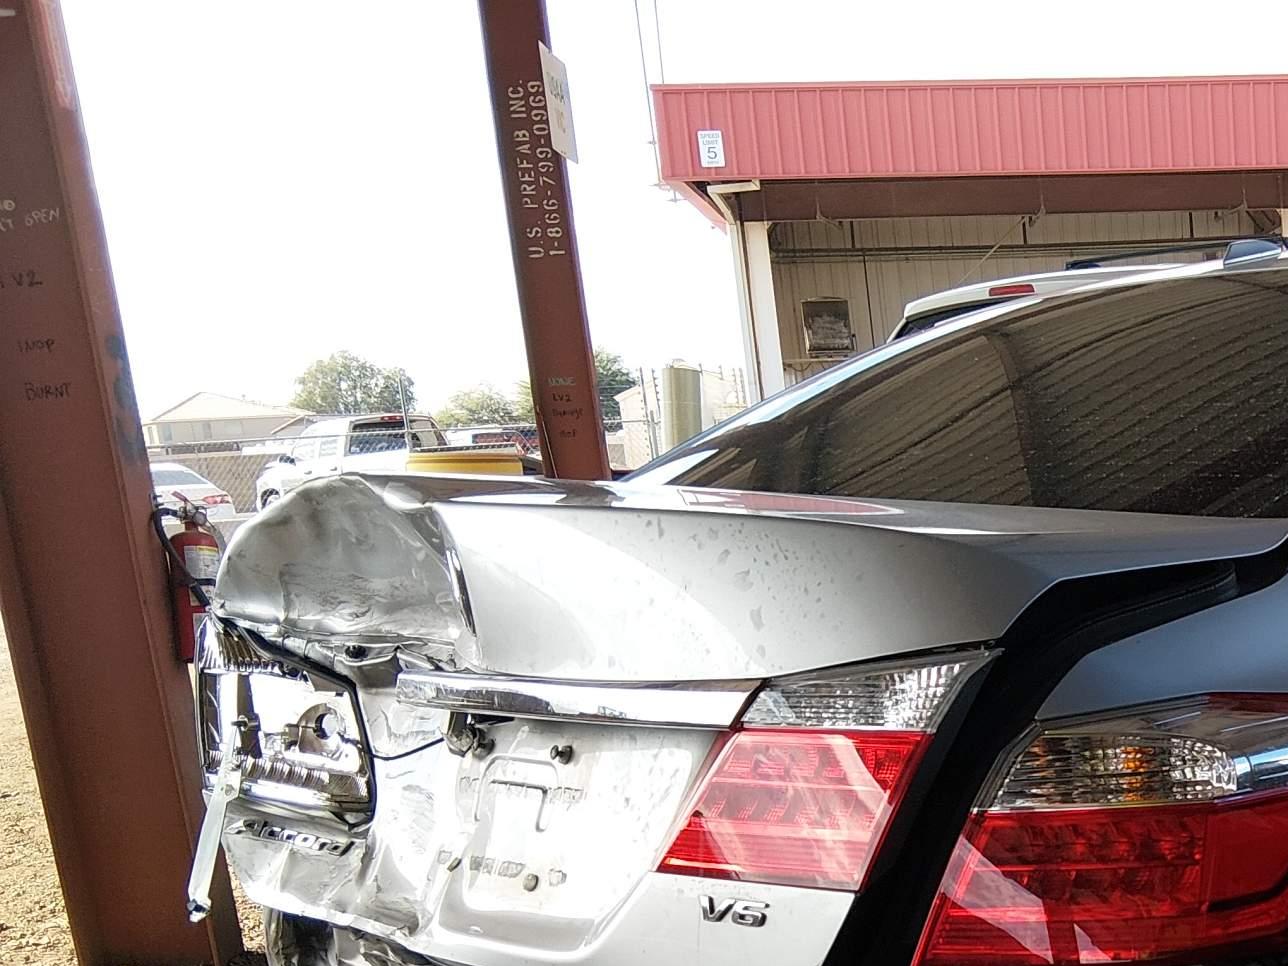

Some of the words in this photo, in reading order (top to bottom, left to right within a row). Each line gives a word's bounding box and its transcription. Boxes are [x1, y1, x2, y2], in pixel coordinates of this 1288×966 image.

[507, 79, 528, 118] INC.
[513, 129, 539, 208] PREFAB
[526, 80, 566, 256] 1-866-799-0969
[707, 146, 718, 160] 5
[25, 207, 60, 226] OPEN
[526, 221, 545, 258] U.S.
[24, 381, 72, 401] BURNT
[223, 819, 356, 857] Accord
[699, 895, 770, 927] V6
